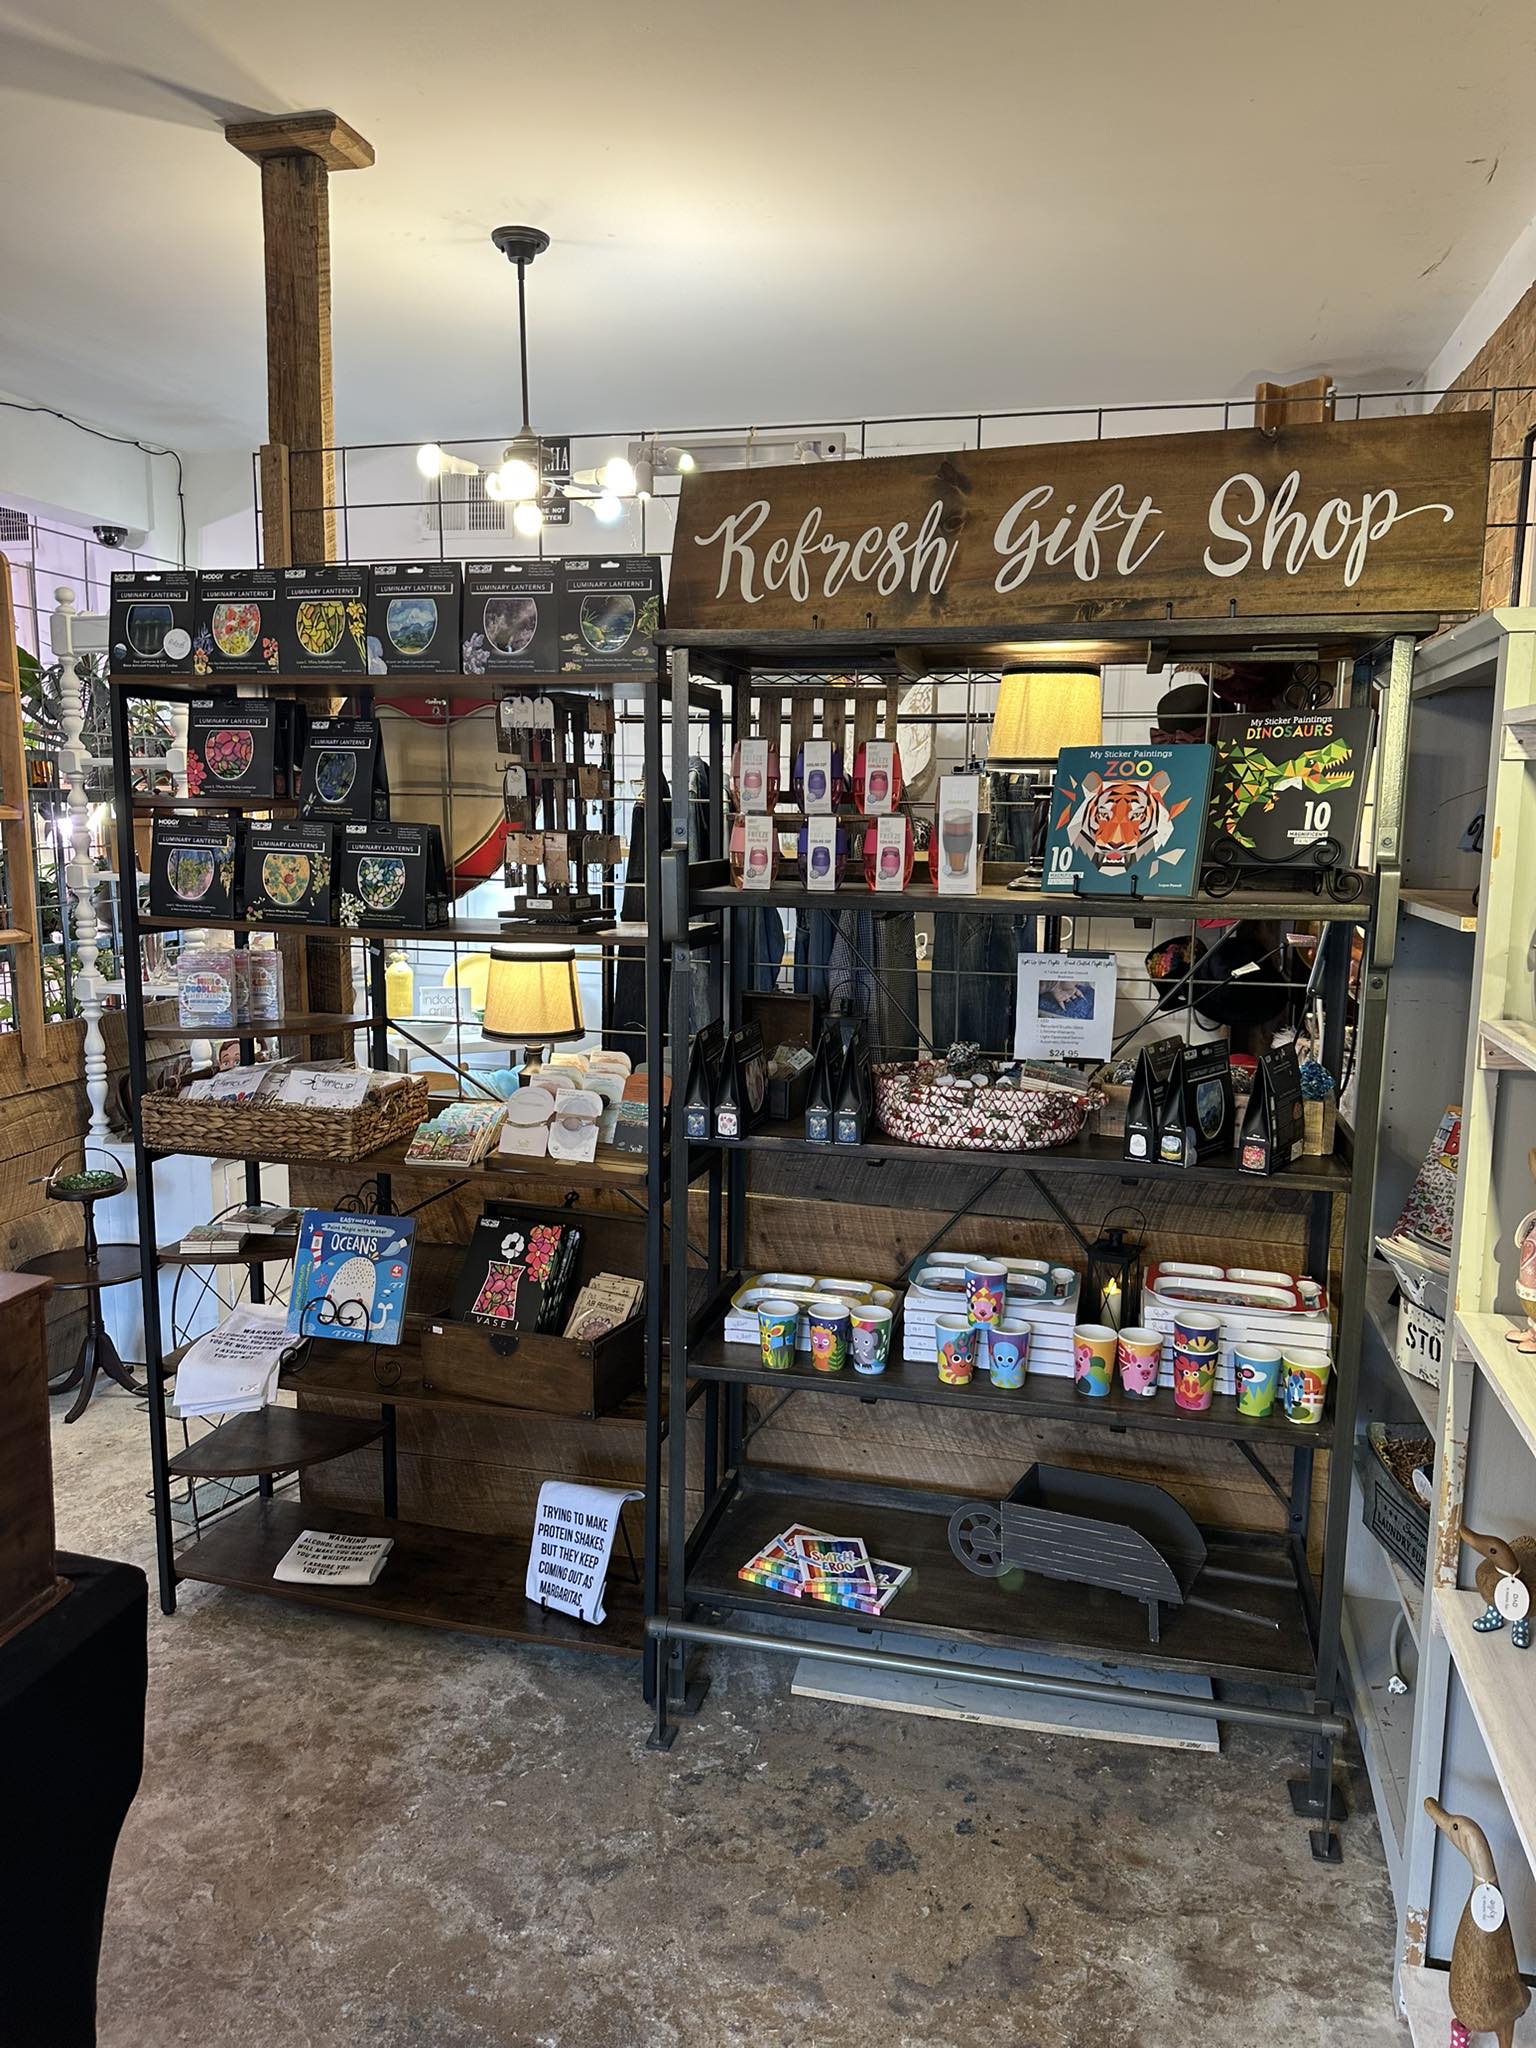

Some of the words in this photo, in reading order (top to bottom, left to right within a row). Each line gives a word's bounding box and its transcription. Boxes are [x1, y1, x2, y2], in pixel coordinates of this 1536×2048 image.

[694, 499, 960, 602] Refresh
[994, 483, 1165, 593] Gift
[1203, 470, 1454, 587] Shop
[381, 585, 412, 593] LUMINARY
[413, 584, 447, 592] LANTERNS
[609, 580, 644, 588] LANTERNS
[237, 590, 269, 598] LANTERNS
[291, 588, 321, 596] LUMINARY
[322, 587, 354, 595] LANTERNS
[1250, 718, 1264, 727] My
[1264, 716, 1291, 725] Sticker
[1292, 715, 1333, 724] Paintings
[1246, 723, 1334, 740] DINOSAURS
[1090, 751, 1102, 759] My
[1104, 750, 1132, 758] Sticker
[1133, 750, 1173, 759] Paintings
[1104, 760, 1153, 777] ZOO
[158, 818, 180, 826] MODGY
[1303, 801, 1332, 831] 10
[162, 836, 191, 844] LUMINARY
[192, 837, 223, 845] LANTERNS
[257, 840, 287, 848] LUMINARY
[288, 841, 318, 849] LANTERNS
[351, 843, 381, 852] LUMINARY
[382, 844, 414, 852] LANTERNS
[1051, 846, 1073, 872] 10
[1049, 1049, 1079, 1057] $24.95
[339, 1216, 355, 1224] EASY
[363, 1218, 377, 1226] FUN
[326, 1224, 341, 1232] Paint
[341, 1225, 357, 1233] Magic
[357, 1226, 370, 1234] with
[330, 1233, 378, 1256] OCEANS
[596, 1301, 625, 1314] FRESHENER
[476, 1316, 507, 1329] VASE
[242, 1328, 284, 1336] WARNING
[543, 1504, 572, 1523] TRYING
[573, 1511, 584, 1526] TO
[585, 1515, 609, 1533] MAKE
[537, 1523, 574, 1542] PROTEIN
[1377, 1511, 1411, 1552] LAUNDRY
[304, 1537, 334, 1548] ALCOHOL
[328, 1534, 368, 1544] WARNING
[297, 1543, 314, 1552] WILL
[315, 1547, 335, 1555] MAKE
[321, 1554, 364, 1562] WHISPERING
[541, 1542, 558, 1556] BUT
[559, 1546, 578, 1564] THEY
[579, 1552, 599, 1570] KEEP
[810, 1550, 856, 1562] SWITCH
[308, 1561, 335, 1570] ASSURE
[822, 1561, 854, 1573] EROO
[538, 1560, 567, 1583] COMING
[567, 1568, 583, 1586] OUT
[583, 1574, 594, 1590] AS
[539, 1580, 583, 1608] MARGARITAS.
